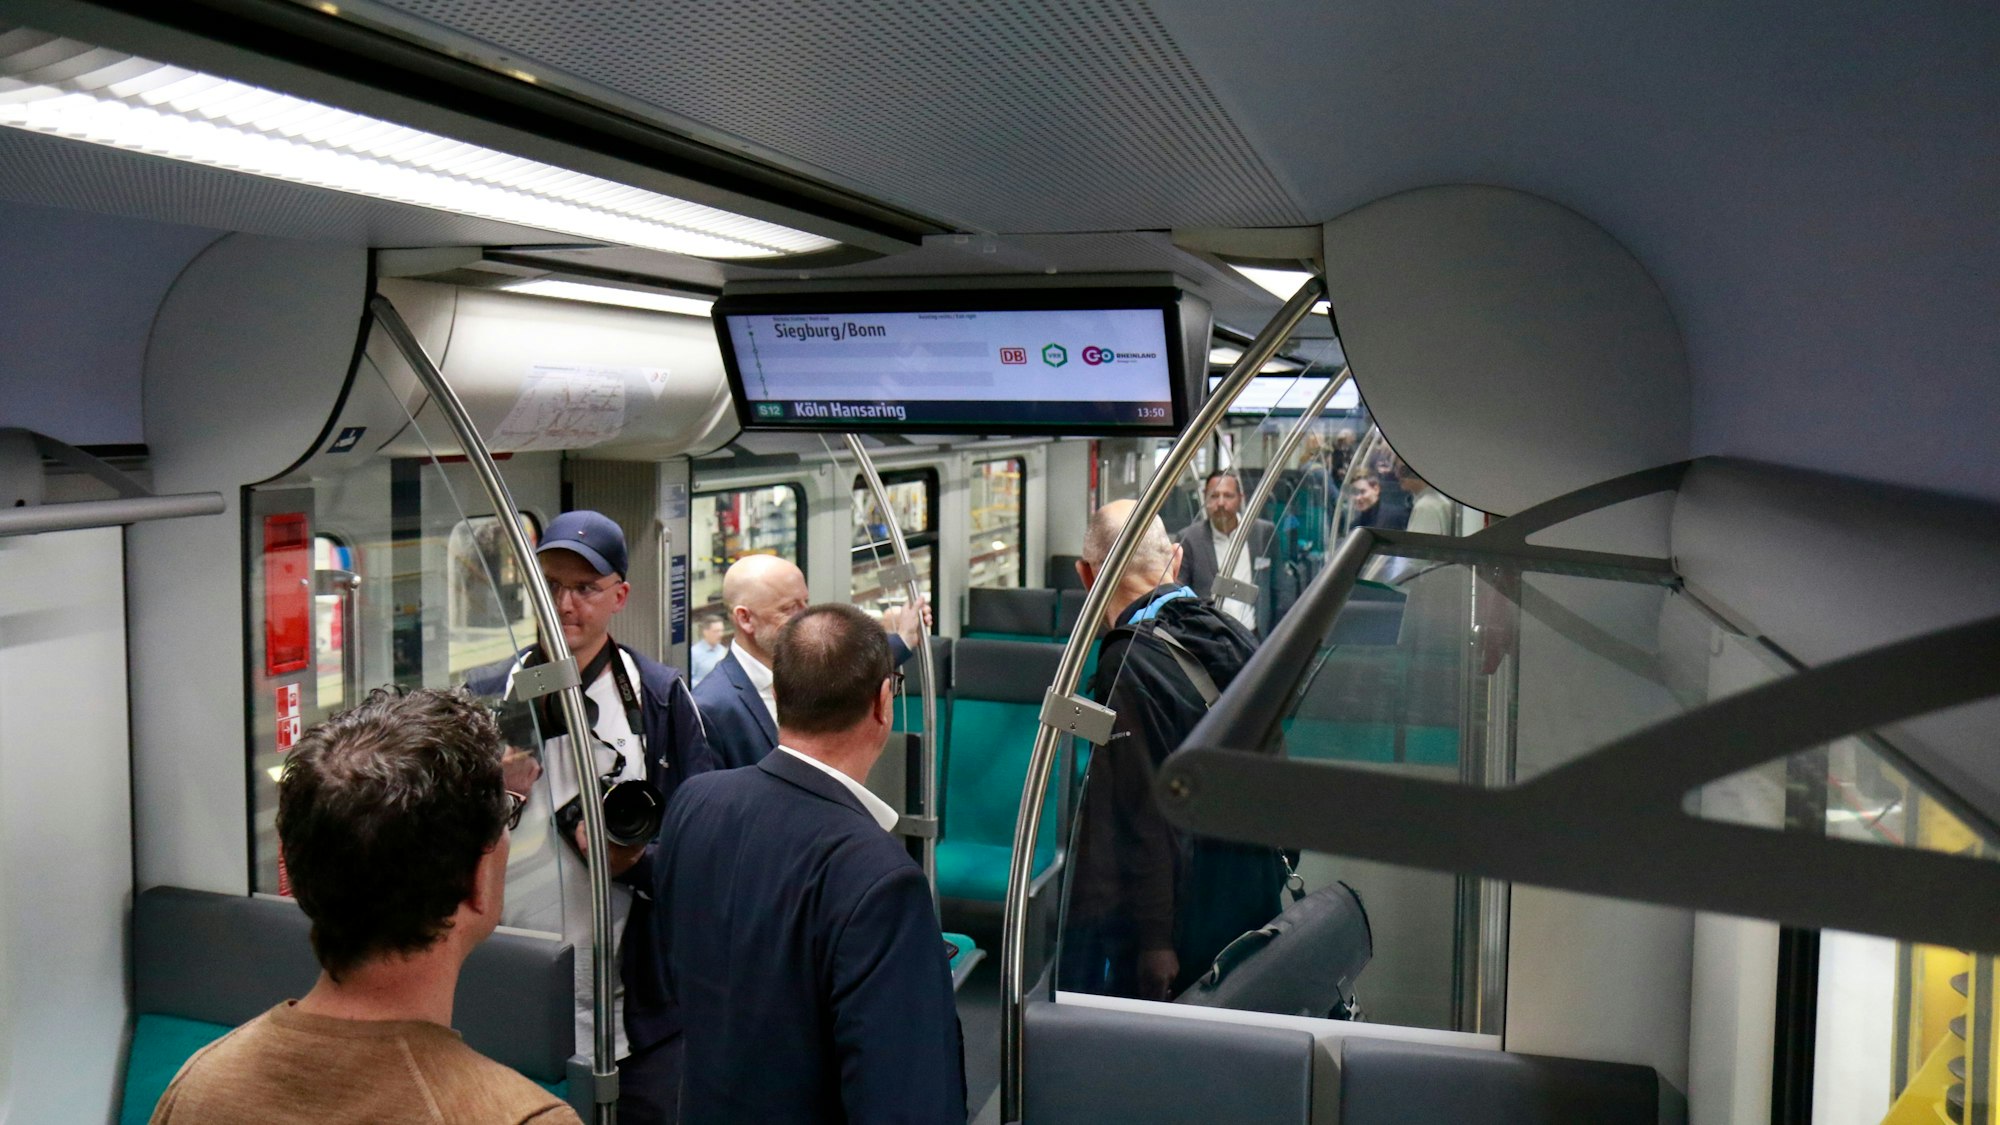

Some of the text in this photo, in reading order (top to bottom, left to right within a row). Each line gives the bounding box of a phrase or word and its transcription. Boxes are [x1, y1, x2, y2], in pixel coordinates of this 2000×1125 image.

[774, 322, 886, 341] Siegburg/Bonn
[1003, 350, 1023, 362] DB
[795, 402, 906, 421] Köln Hansaring
[1137, 407, 1165, 418] 13:50
